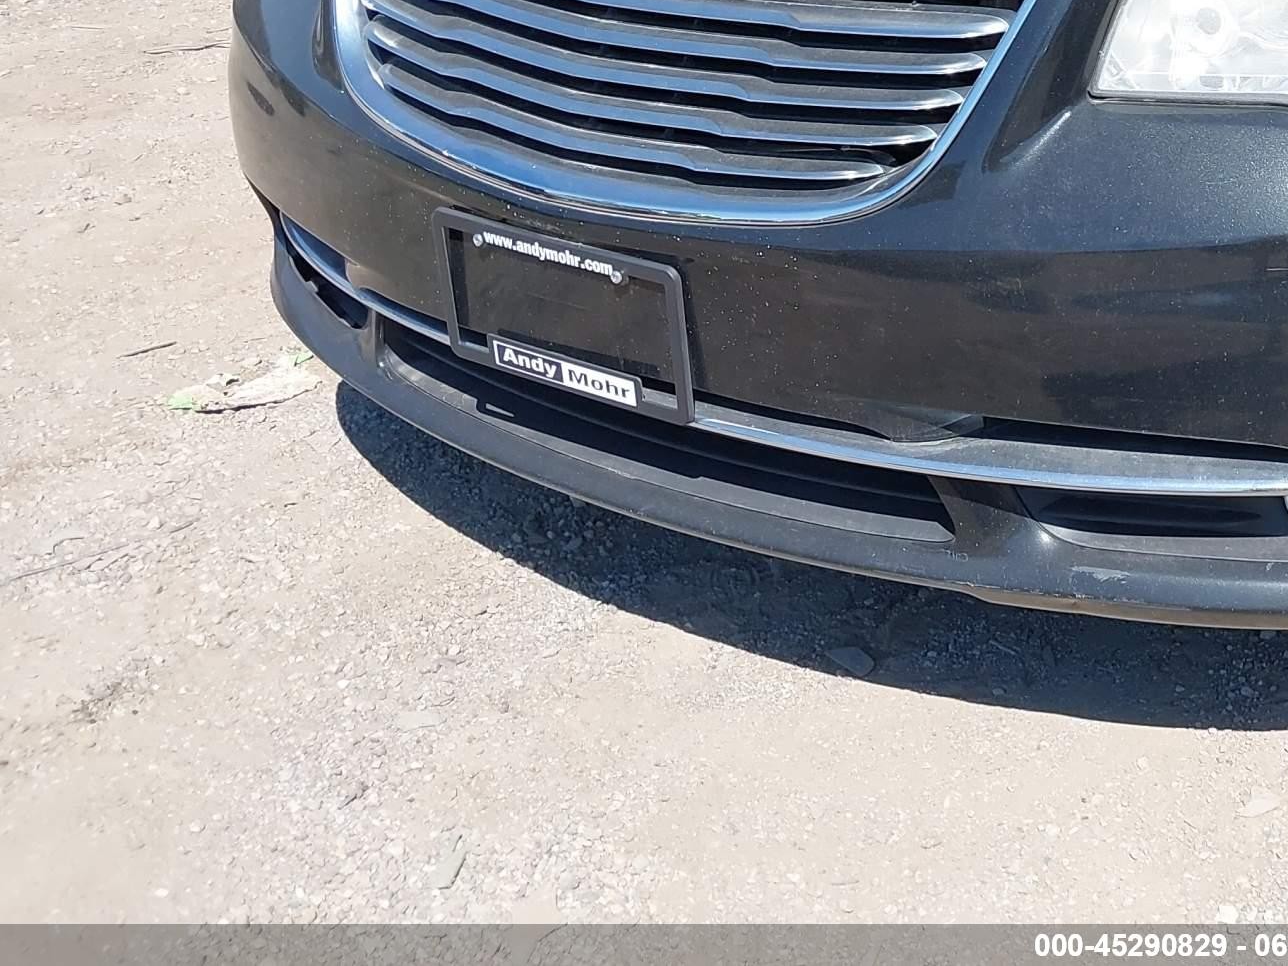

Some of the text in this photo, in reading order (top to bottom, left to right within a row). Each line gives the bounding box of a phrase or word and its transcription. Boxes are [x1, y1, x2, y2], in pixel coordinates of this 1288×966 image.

[483, 231, 613, 275] www.andymohr.com
[503, 348, 630, 398] Andy Mohr
